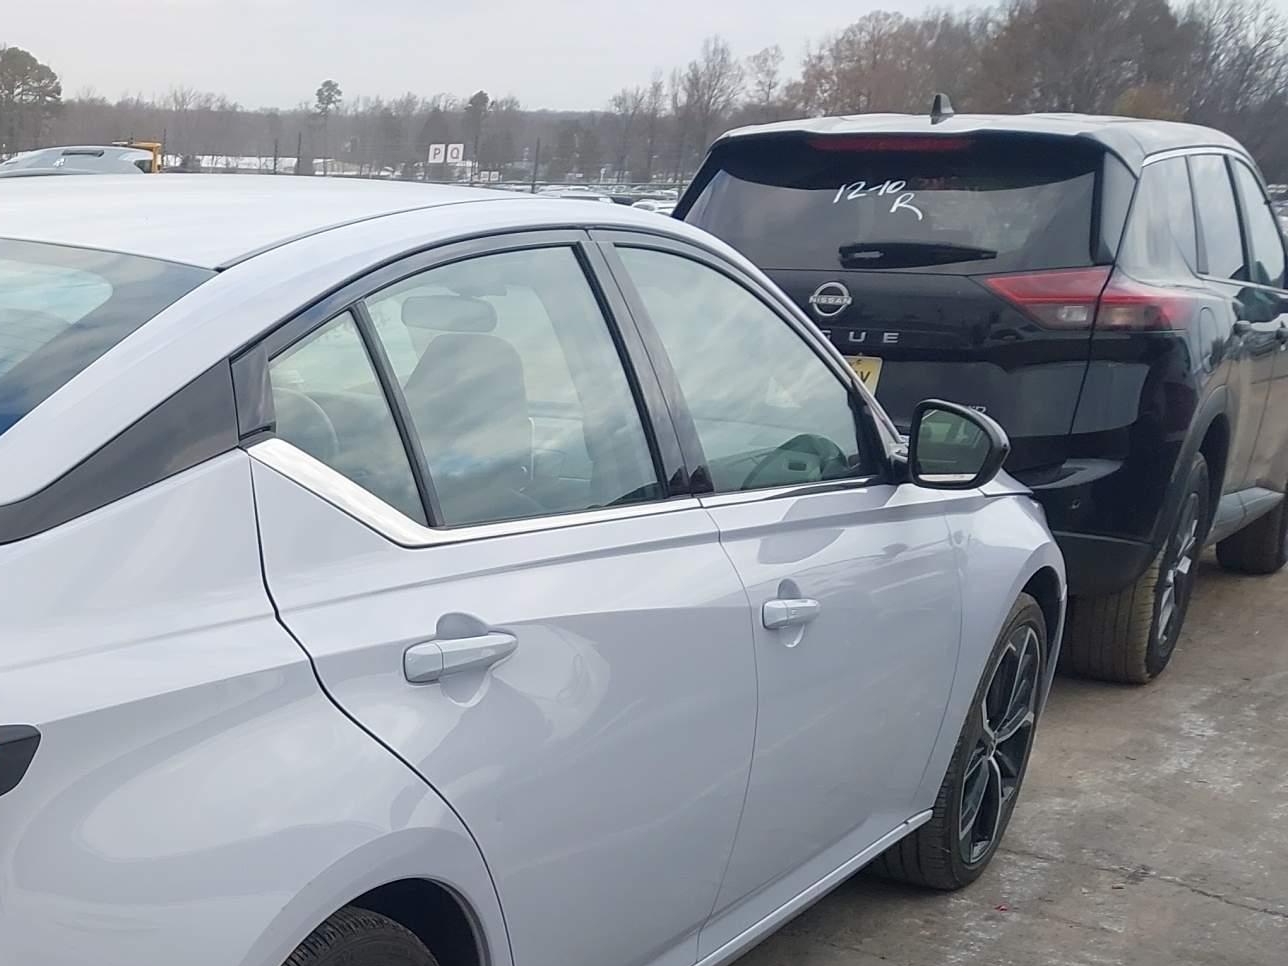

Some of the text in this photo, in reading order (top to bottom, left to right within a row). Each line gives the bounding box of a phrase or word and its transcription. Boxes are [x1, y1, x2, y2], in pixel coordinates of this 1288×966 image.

[833, 180, 906, 203] 12-10
[889, 192, 923, 221] R
[809, 295, 852, 305] NISSAN
